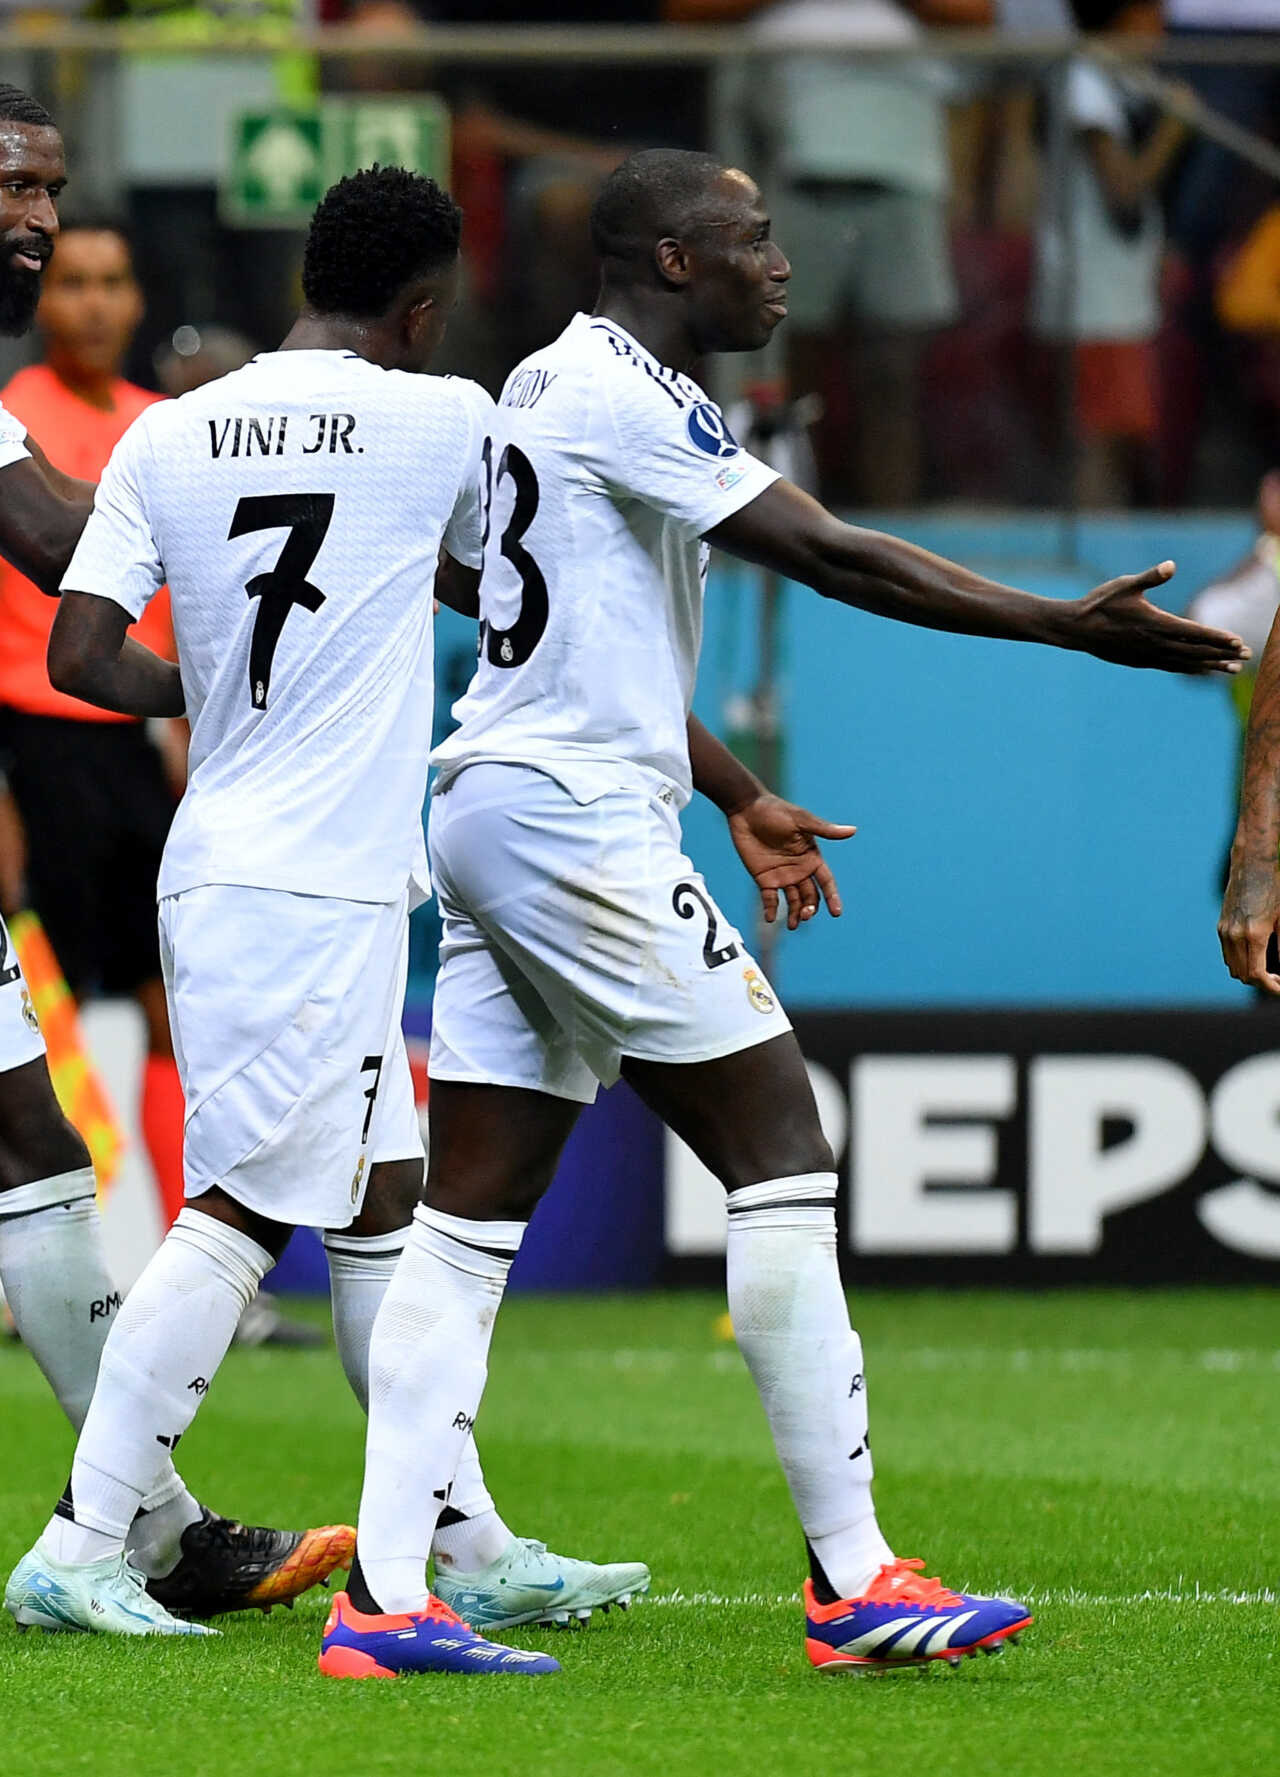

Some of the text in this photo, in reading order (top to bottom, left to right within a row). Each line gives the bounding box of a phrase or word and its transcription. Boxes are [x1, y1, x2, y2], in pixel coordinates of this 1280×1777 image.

[208, 413, 365, 459] VINI JR.
[227, 493, 335, 711] 7
[478, 435, 549, 669] 3
[665, 1052, 1280, 1262] EP
